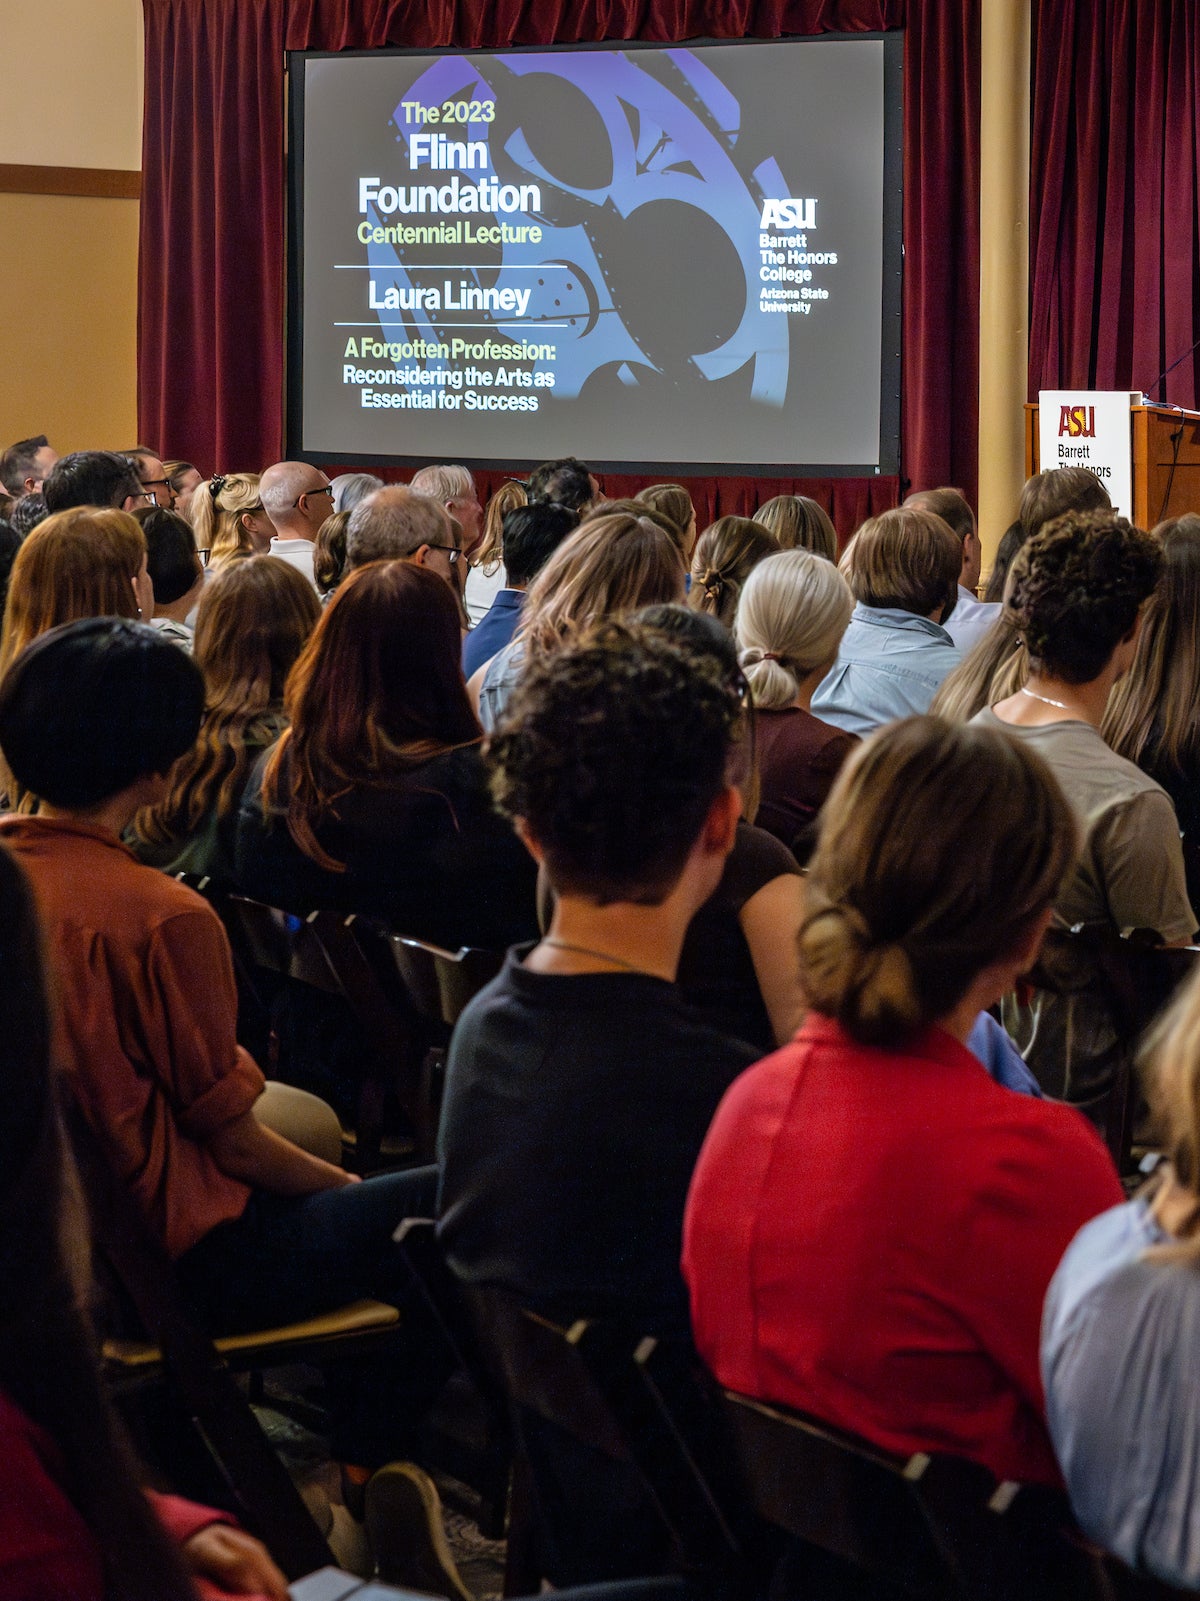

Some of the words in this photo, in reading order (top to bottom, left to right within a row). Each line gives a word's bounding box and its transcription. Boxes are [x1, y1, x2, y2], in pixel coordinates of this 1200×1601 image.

[401, 102, 440, 123] The
[442, 101, 495, 123] 2023
[409, 133, 488, 170] Flinn
[359, 176, 541, 213] Foundation
[760, 199, 818, 229] ASU
[357, 221, 462, 244] Centennial
[465, 225, 542, 243] Lecture
[760, 234, 807, 248] Barrett
[760, 250, 785, 264] The
[788, 251, 838, 264] Honors
[760, 267, 812, 283] College
[369, 280, 440, 310] Laura
[444, 281, 531, 315] Linney
[760, 288, 799, 299] Arizona
[800, 288, 829, 299] State
[760, 301, 811, 314] University
[344, 338, 360, 358] A
[361, 338, 449, 362] Forgotten
[451, 338, 556, 361] Profession:
[343, 364, 462, 388] Reconsidering
[466, 367, 492, 387] the
[495, 368, 533, 387] Arts
[534, 372, 555, 387] as
[361, 389, 436, 409] Essential
[438, 390, 461, 409] for
[464, 391, 539, 411] Success
[1058, 406, 1096, 437] ASU
[1058, 444, 1090, 458] Barrett
[1077, 462, 1112, 478] nors
